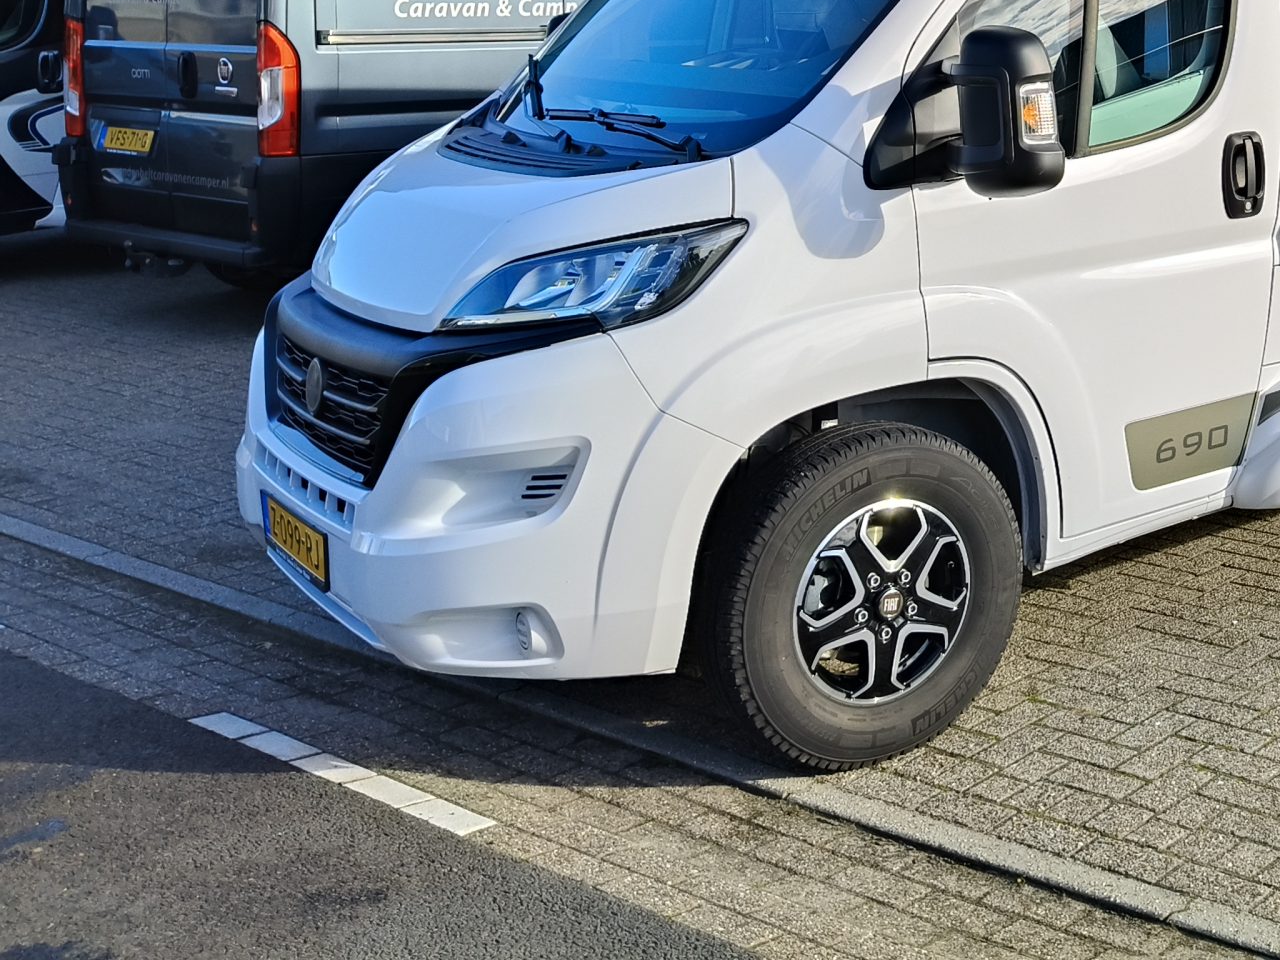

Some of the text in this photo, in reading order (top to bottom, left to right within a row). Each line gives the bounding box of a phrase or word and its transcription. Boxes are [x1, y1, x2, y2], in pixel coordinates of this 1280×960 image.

[496, 0, 513, 18] &
[109, 130, 149, 148] VFS-71-G
[1155, 424, 1229, 464] 690
[883, 597, 900, 612] FIAT
